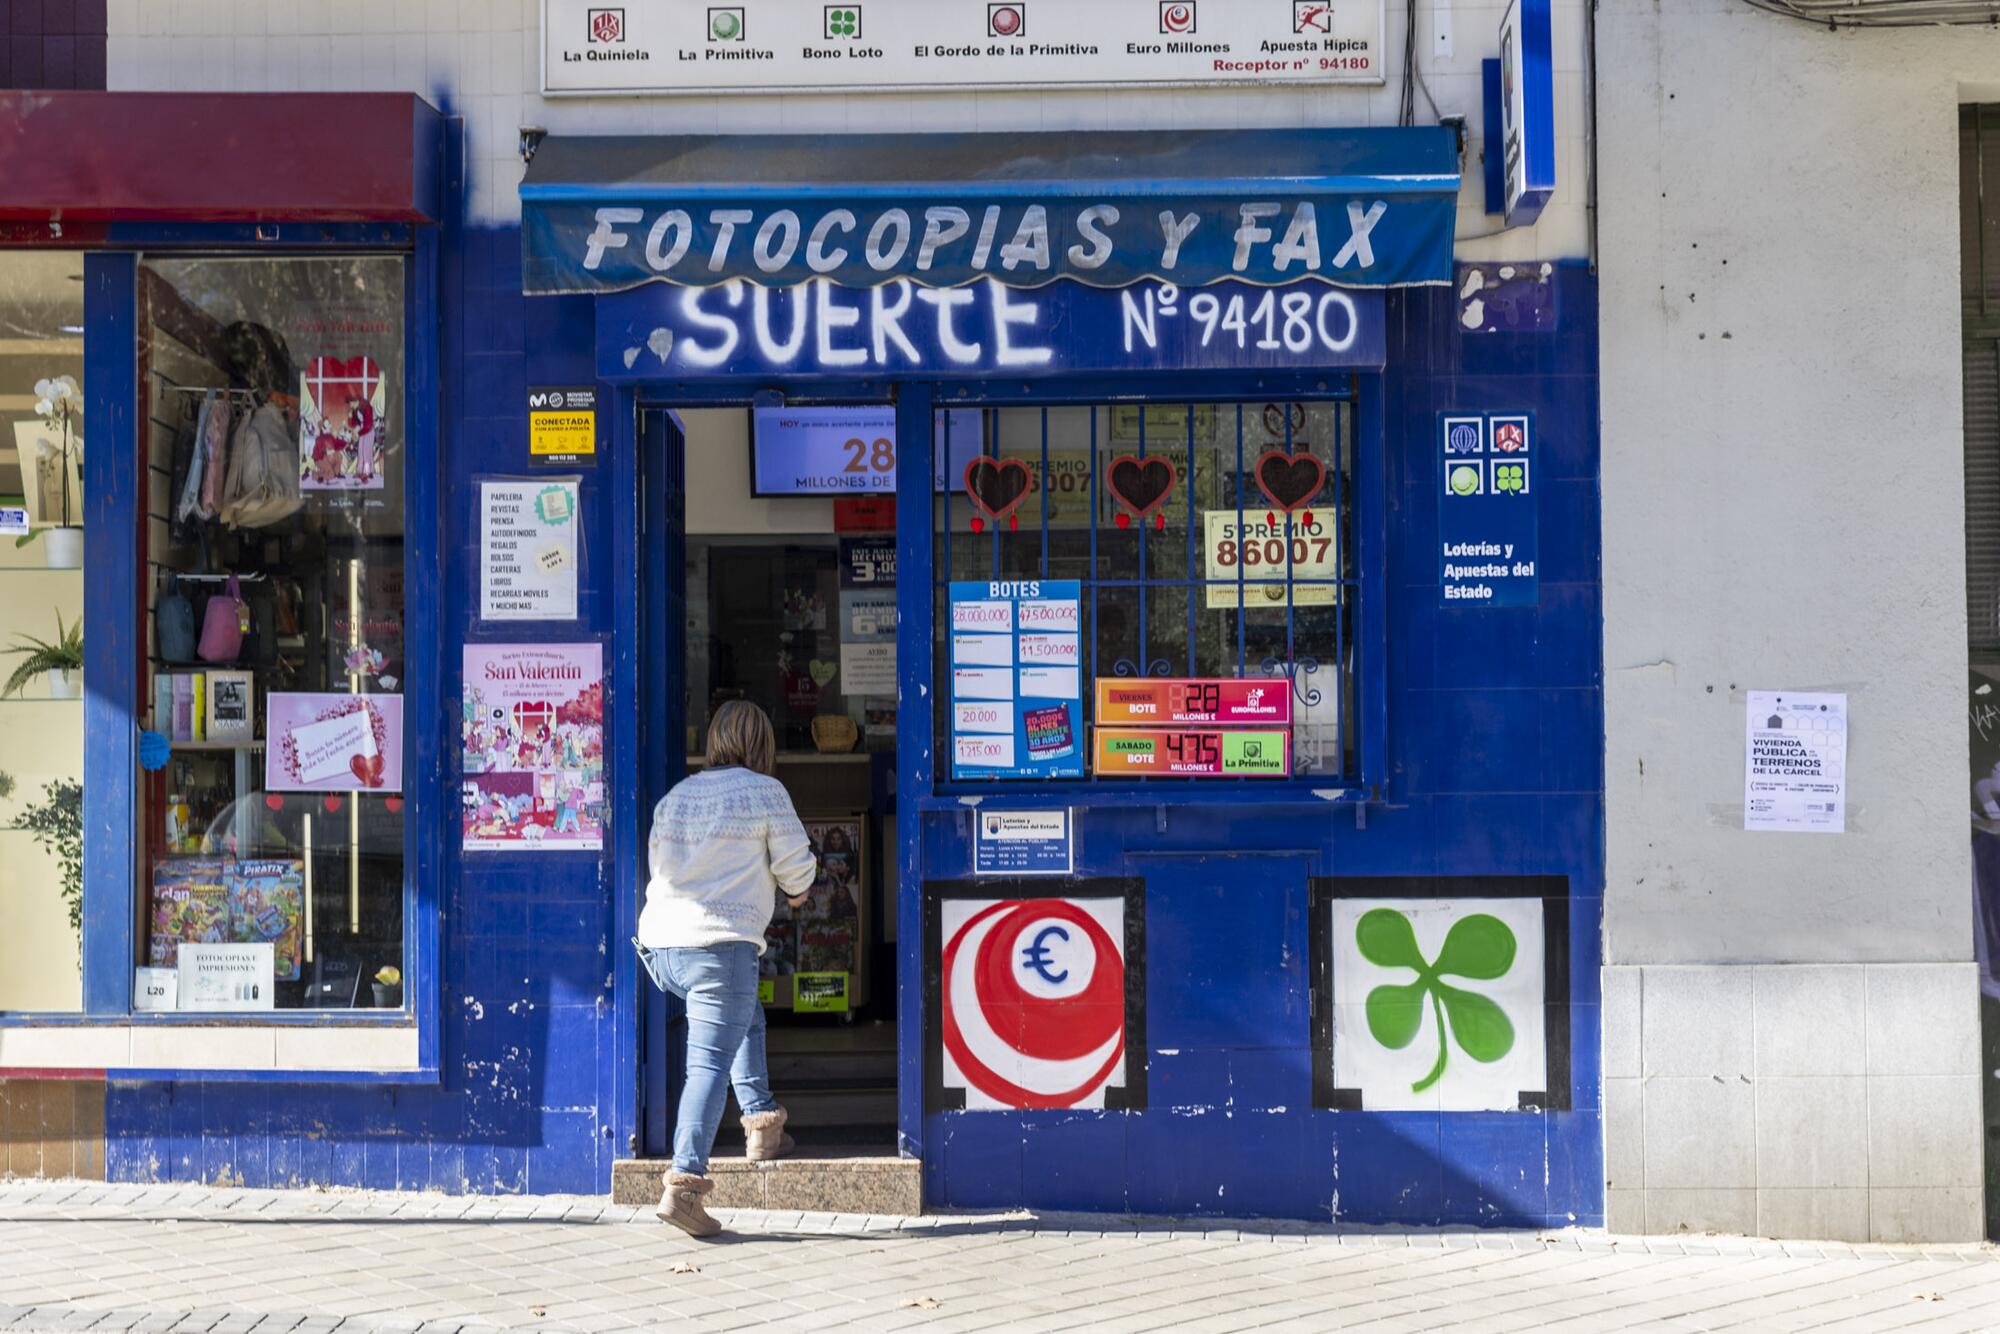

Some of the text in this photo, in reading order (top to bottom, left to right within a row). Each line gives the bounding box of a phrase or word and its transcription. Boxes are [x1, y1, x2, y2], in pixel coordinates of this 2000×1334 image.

[802, 46, 883, 59] Bono Loto
[914, 43, 1099, 57] El Gordo de la Primitiva
[1126, 41, 1230, 54] Euro Millones
[1260, 40, 1318, 54] Apuesta
[563, 49, 650, 62] La Quiniela
[678, 48, 774, 61] La Primitiva
[1213, 58, 1289, 73] Receptor
[1319, 57, 1369, 70] 94180
[583, 200, 1388, 273] FOTOCOPIAS Y FAX
[679, 276, 1358, 367] SUERTE Nº 94180
[535, 418, 590, 426] CONECTADA
[780, 419, 800, 427] HOY
[842, 437, 895, 473] 28
[795, 476, 891, 489] MILLONES DE
[490, 505, 520, 514] REVISTAS
[490, 517, 515, 526] PRENSA
[491, 529, 537, 537] AUTODEFINIDOS
[1242, 521, 1323, 539] PREMIO
[490, 541, 518, 550] REGALOS
[1444, 541, 1514, 559] Loterías y
[490, 553, 515, 562] BOLSOS
[1217, 537, 1332, 567] 86007
[490, 565, 522, 574] CARTERAS
[1444, 562, 1535, 580] Apuestas del
[490, 577, 512, 586] LIBROS
[490, 589, 522, 598] RECARGAS
[989, 581, 1040, 598] BOTES
[1444, 583, 1493, 599] Estado
[490, 602, 495, 610] Y
[496, 601, 518, 610] MUCHO
[485, 660, 582, 681] San Valentín
[1119, 694, 1153, 702] VIERNES
[1185, 684, 1220, 713] 28
[1129, 703, 1157, 714] BOTE
[1231, 706, 1277, 714] EUROMILLONES
[1172, 713, 1216, 721] MILLONES €
[1115, 741, 1152, 750] SABADO
[1753, 739, 1802, 748] VIVIENDA
[1753, 746, 1807, 757] PÚBLICA
[1127, 754, 1155, 764] BOTE
[1225, 759, 1280, 769] La Primitiva
[1752, 757, 1822, 768] TERRENOS
[1170, 763, 1214, 772] MILLONES €
[1783, 767, 1822, 776] CÁRCEL
[243, 863, 285, 876] PIRATIX
[160, 886, 190, 903] clan
[196, 954, 251, 963] FOTOCOPIAS
[198, 964, 256, 972] IMPRESIONES
[147, 986, 165, 996] L20
